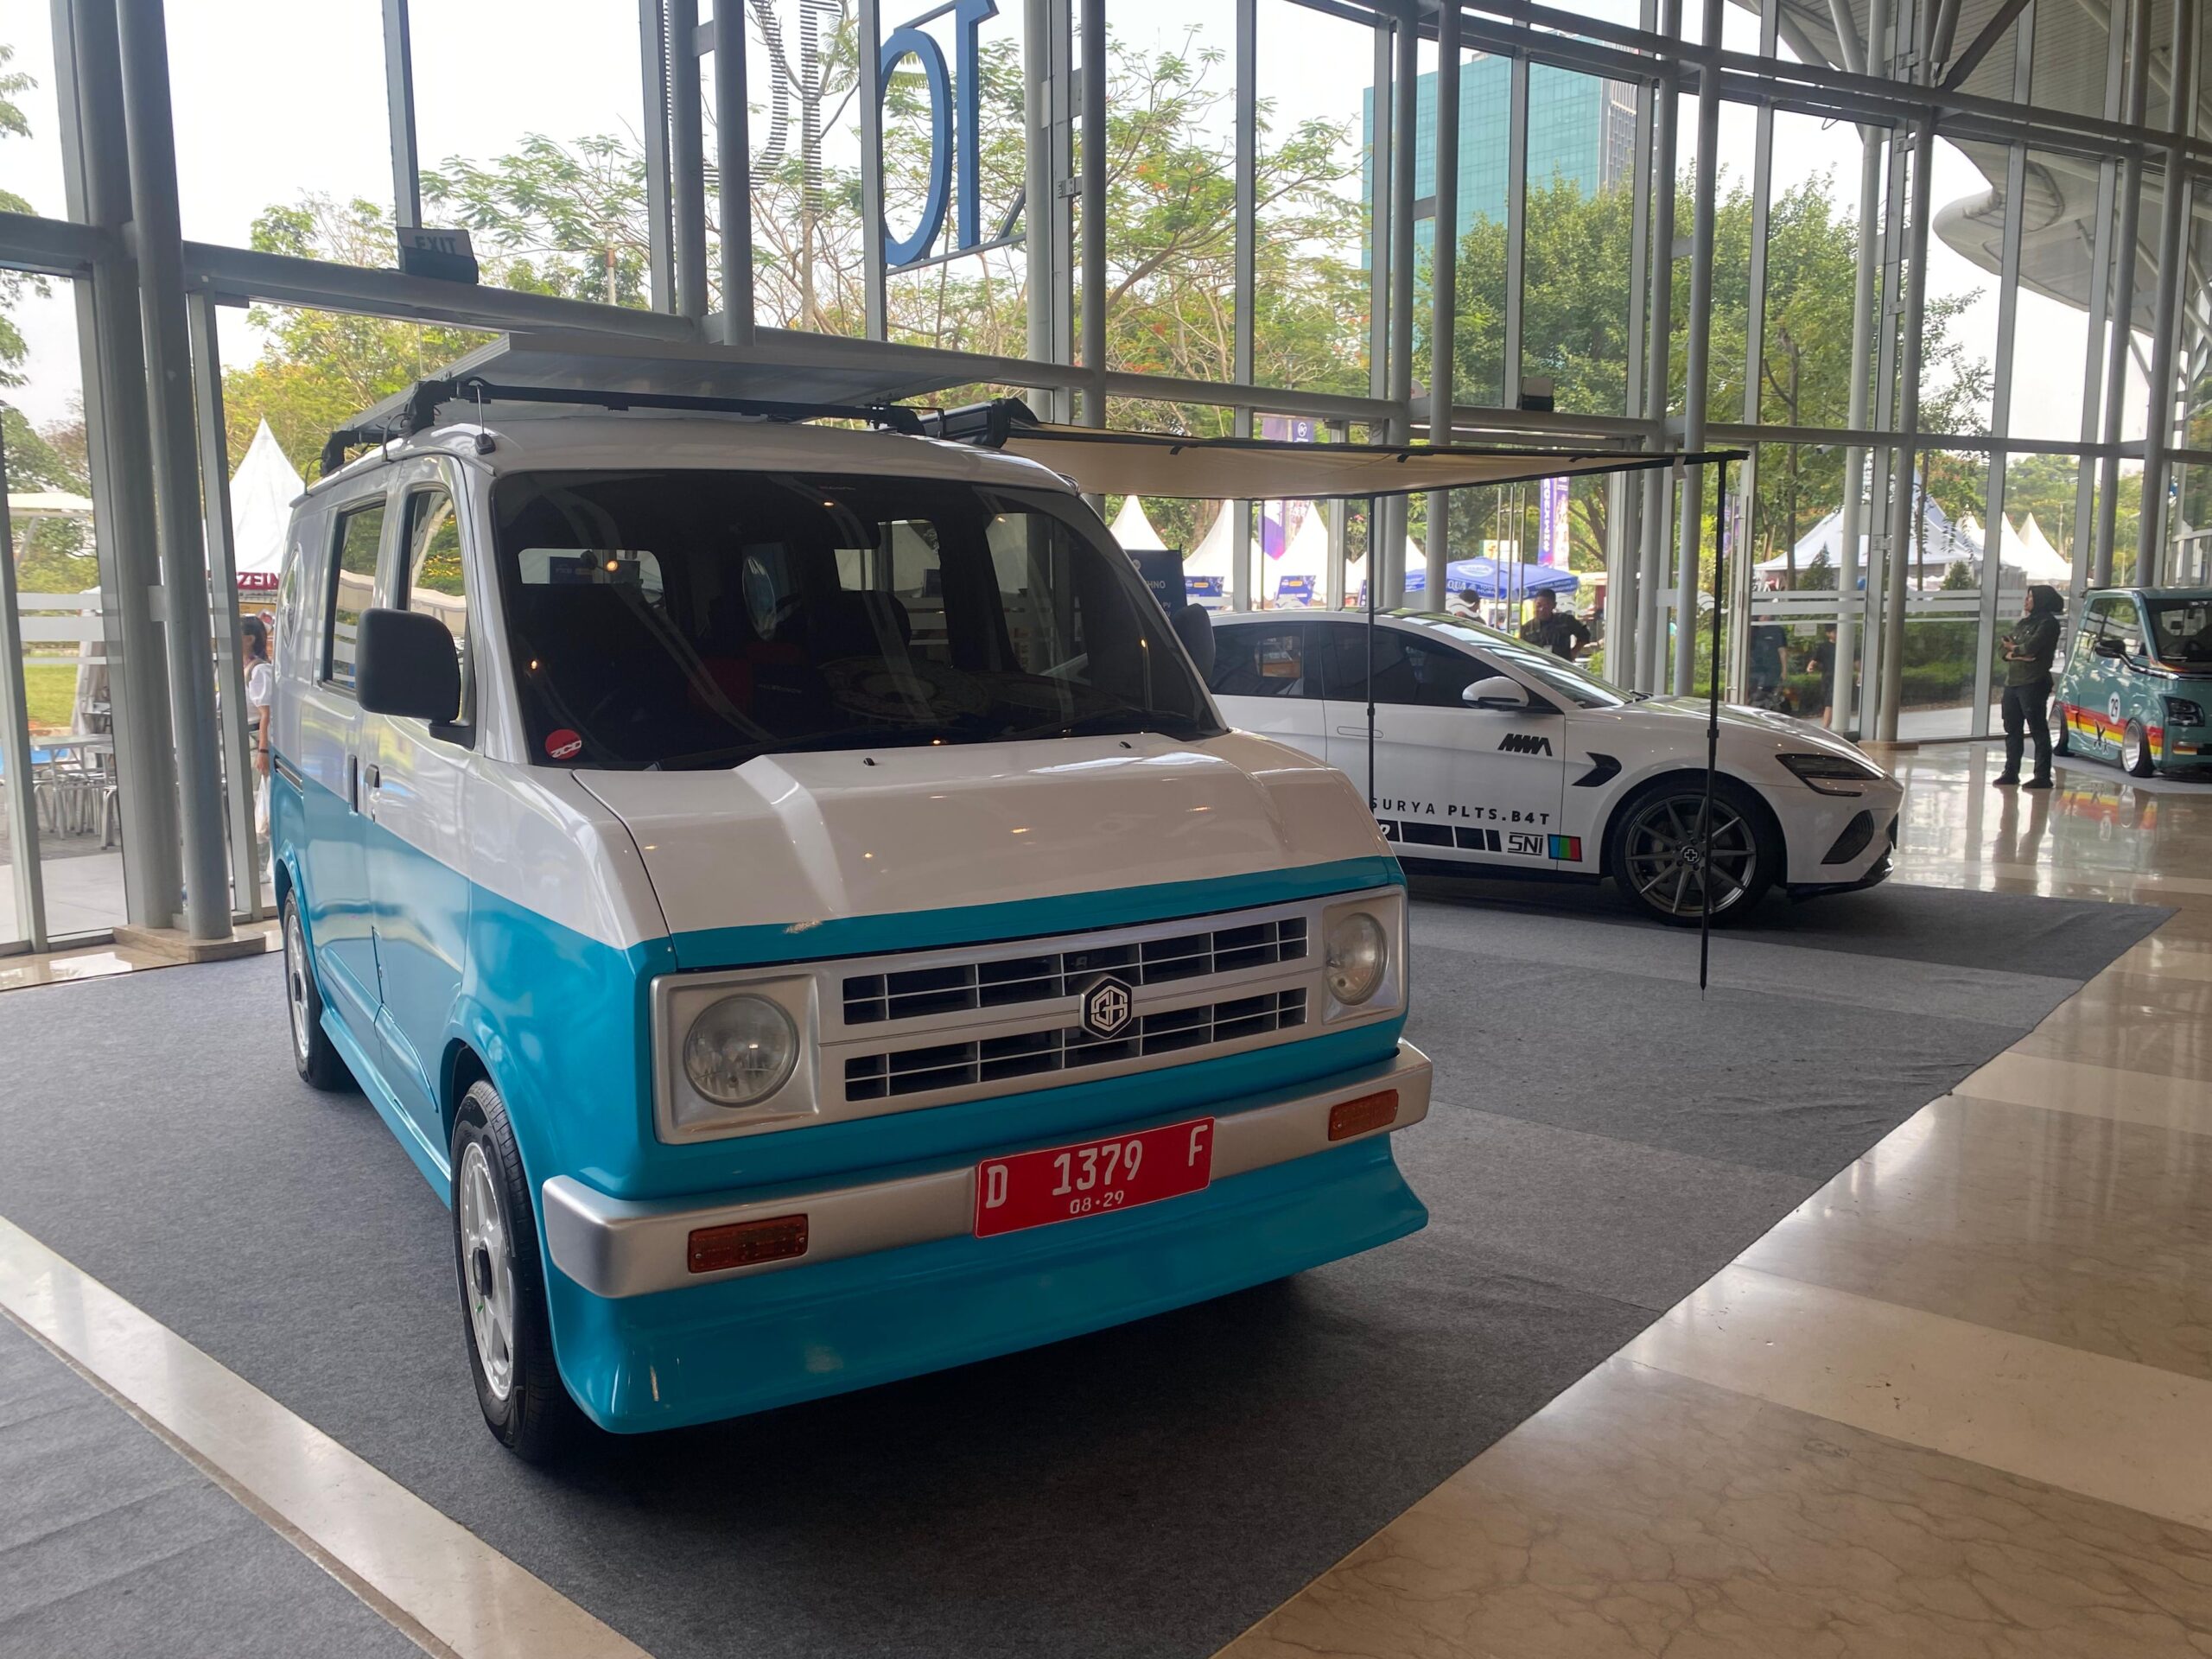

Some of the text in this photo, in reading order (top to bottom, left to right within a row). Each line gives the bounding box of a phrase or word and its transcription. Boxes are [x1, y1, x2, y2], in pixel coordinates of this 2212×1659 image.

[415, 235, 456, 255] EXIT
[1448, 804, 1549, 825] PLTS.B4T
[1508, 832, 1543, 855] SNI
[986, 1125, 1208, 1208] D 1379 F
